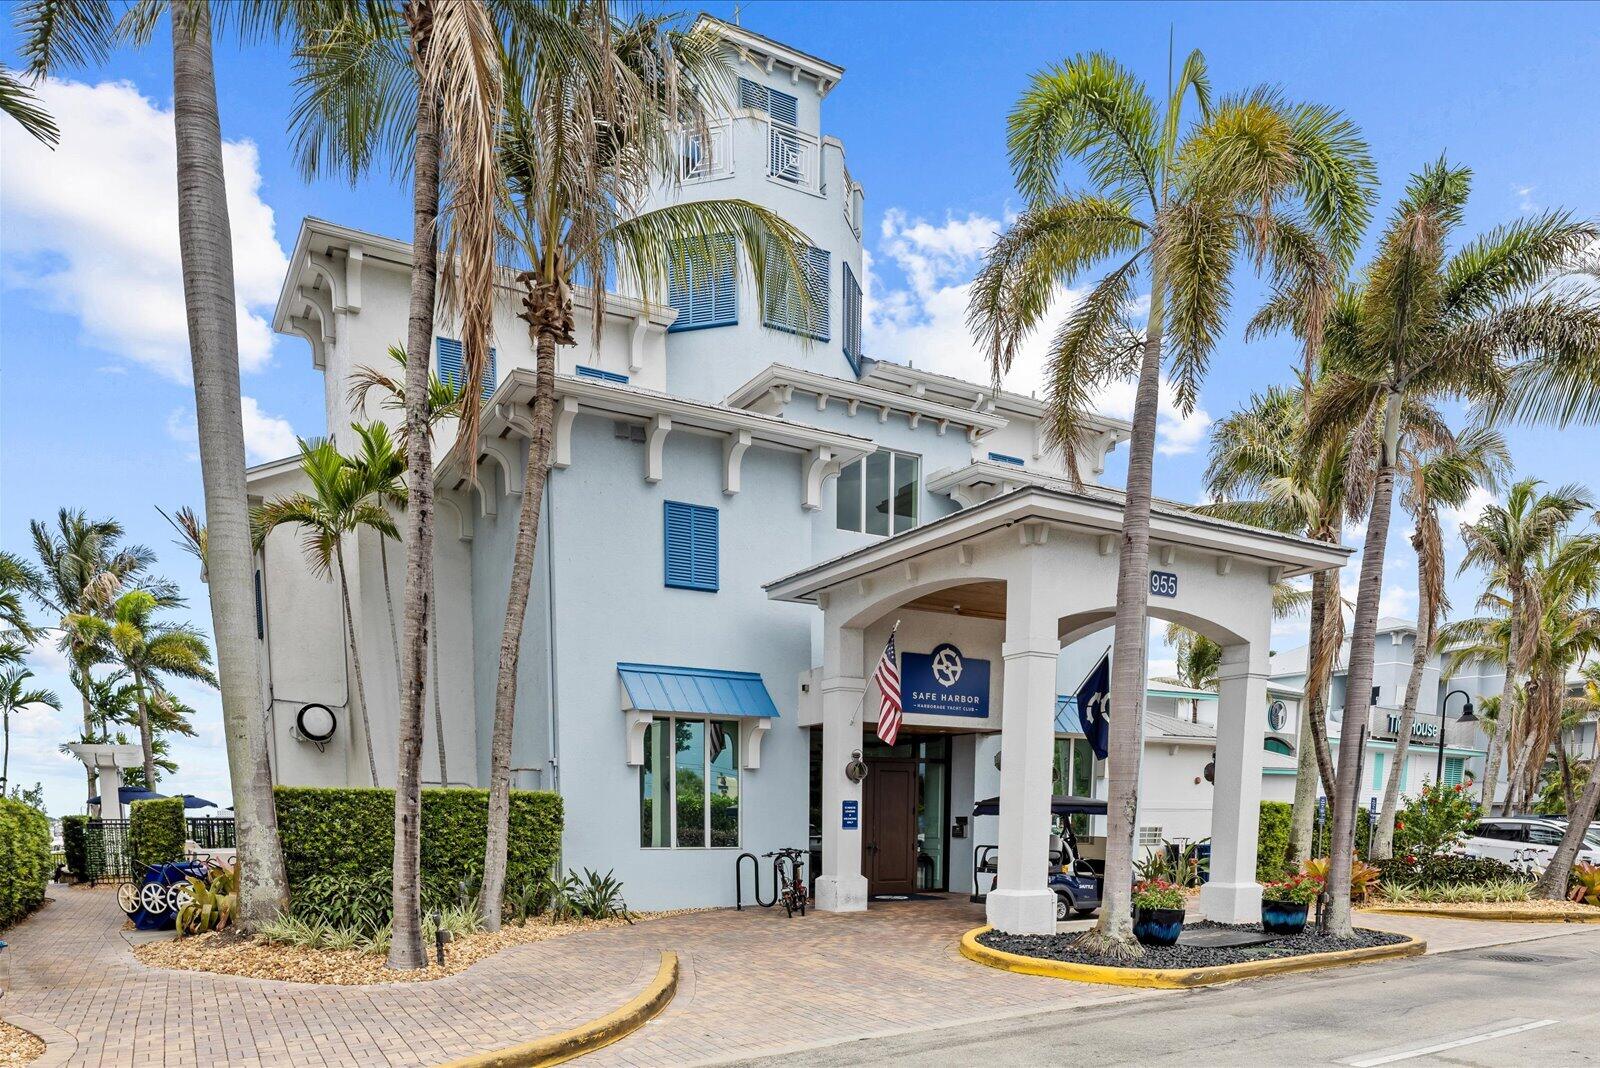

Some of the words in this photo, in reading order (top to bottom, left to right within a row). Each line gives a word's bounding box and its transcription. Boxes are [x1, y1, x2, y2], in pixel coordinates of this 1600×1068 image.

[1151, 574, 1176, 595] 955
[912, 691, 937, 701] SAFE
[941, 693, 980, 704] HARBOR
